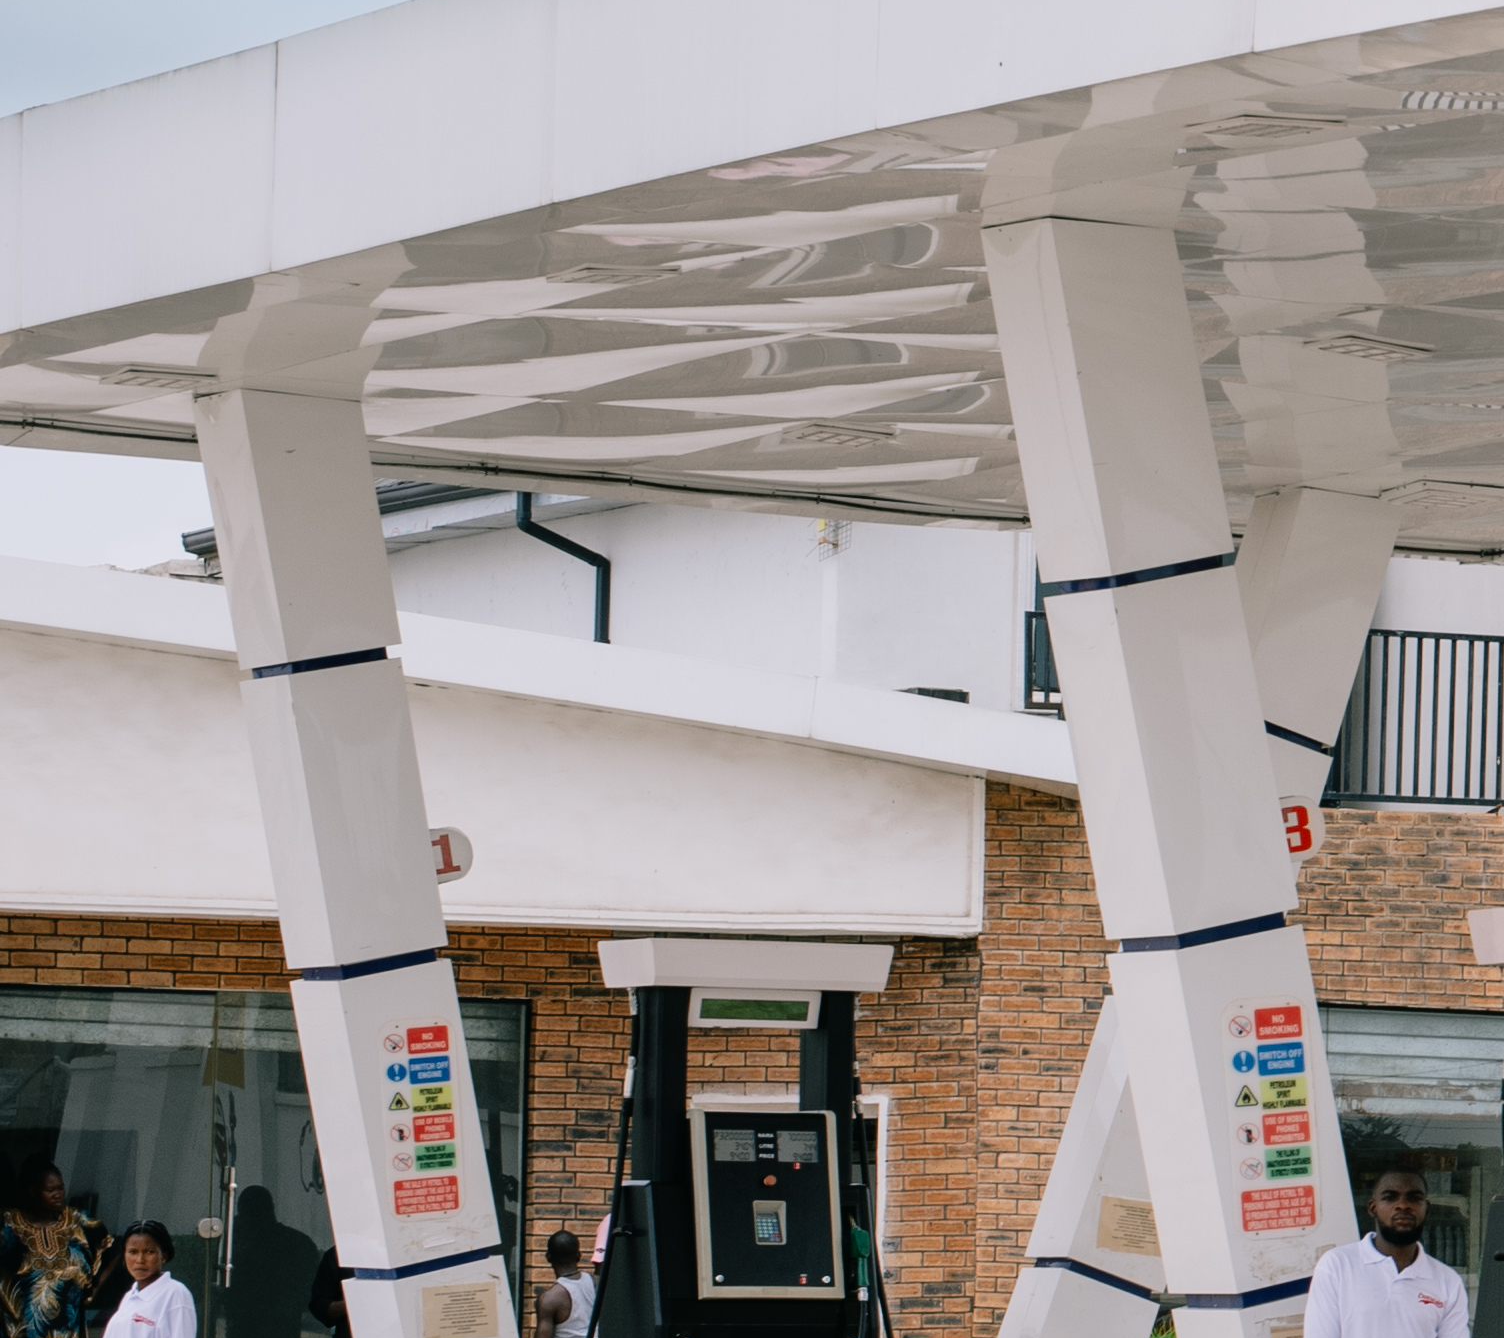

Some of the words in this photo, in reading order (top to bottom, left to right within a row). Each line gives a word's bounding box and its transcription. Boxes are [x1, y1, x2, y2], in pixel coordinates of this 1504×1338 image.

[1281, 805, 1312, 853] 3
[431, 834, 461, 875] 1
[1271, 1014, 1285, 1023] NO
[1259, 1024, 1299, 1035] SMOKING
[422, 1032, 434, 1040] NO
[410, 1040, 446, 1051] SMOKING
[1259, 1050, 1287, 1061] SWITCH
[1288, 1048, 1302, 1058] OFF
[410, 1063, 435, 1071] SWITCH
[436, 1061, 448, 1069] OFF
[1267, 1059, 1295, 1070] ENGINE
[418, 1070, 442, 1079] ENGINE
